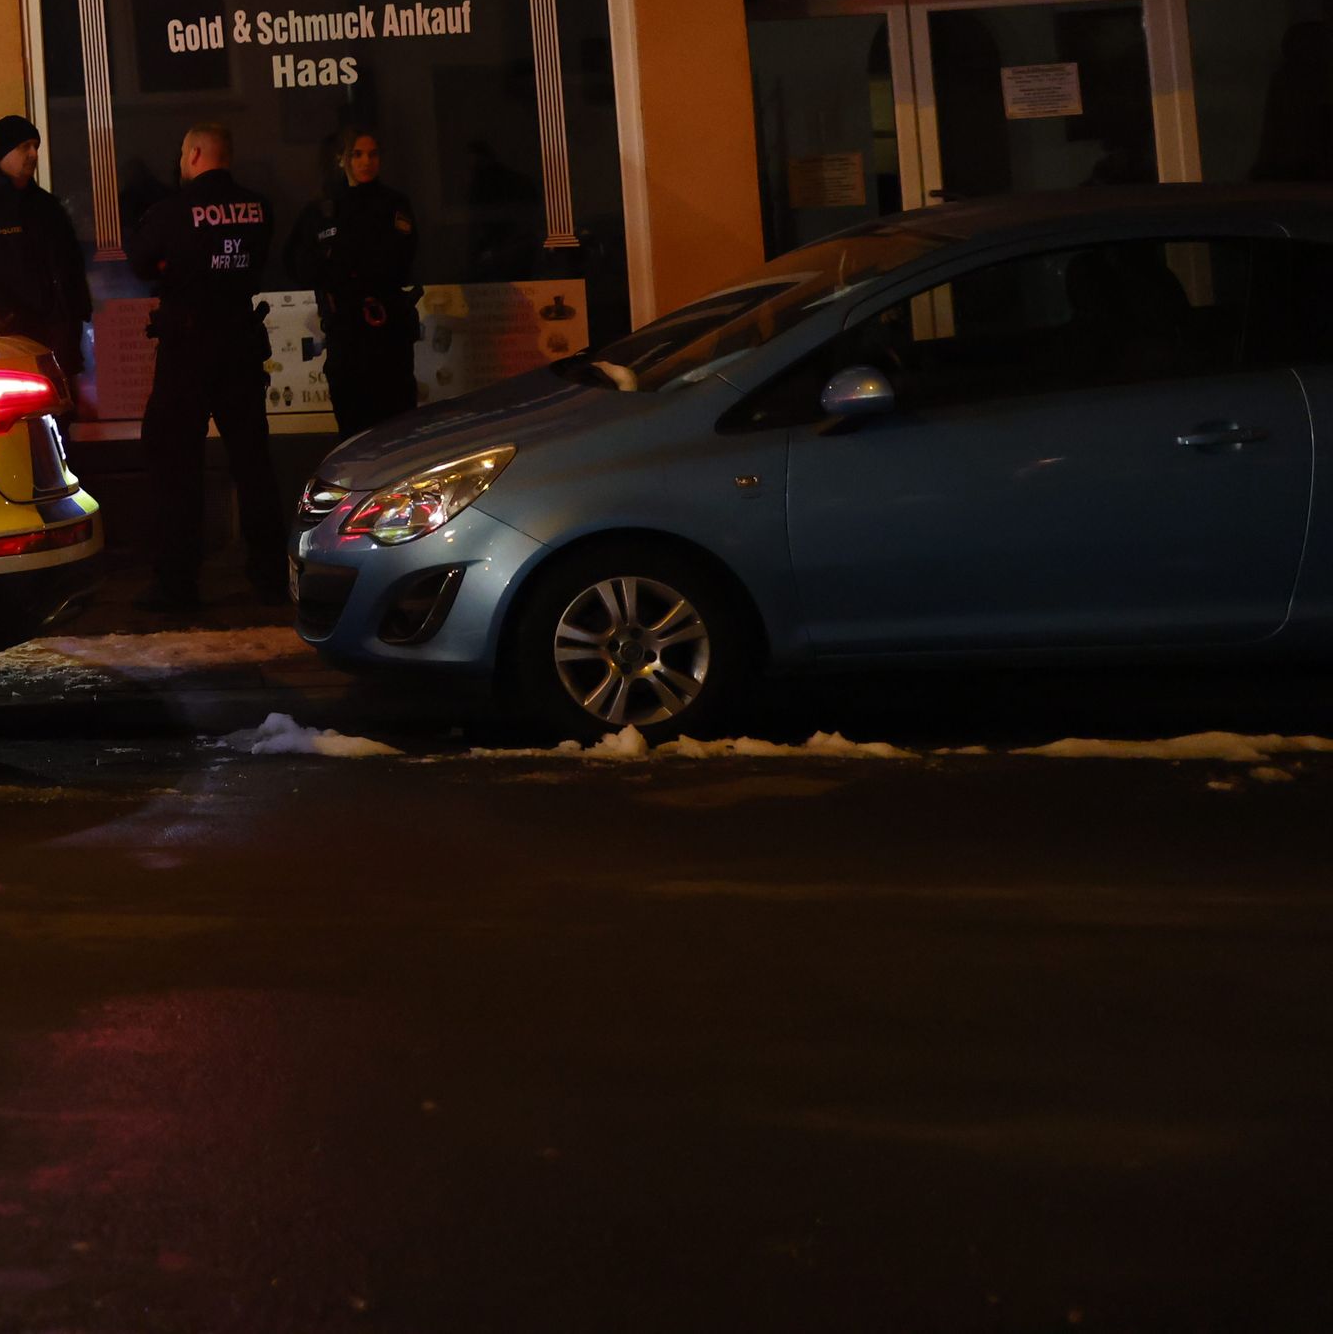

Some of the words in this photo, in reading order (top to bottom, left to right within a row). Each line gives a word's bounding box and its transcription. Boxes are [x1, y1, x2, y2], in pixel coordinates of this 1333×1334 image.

[167, 15, 225, 54] Gold
[233, 9, 253, 44] &
[257, 4, 376, 46] Schmuck
[383, 0, 472, 38] Ankauf
[271, 53, 359, 89] Haas
[191, 202, 264, 227] POLIZEI
[223, 238, 242, 254] BY
